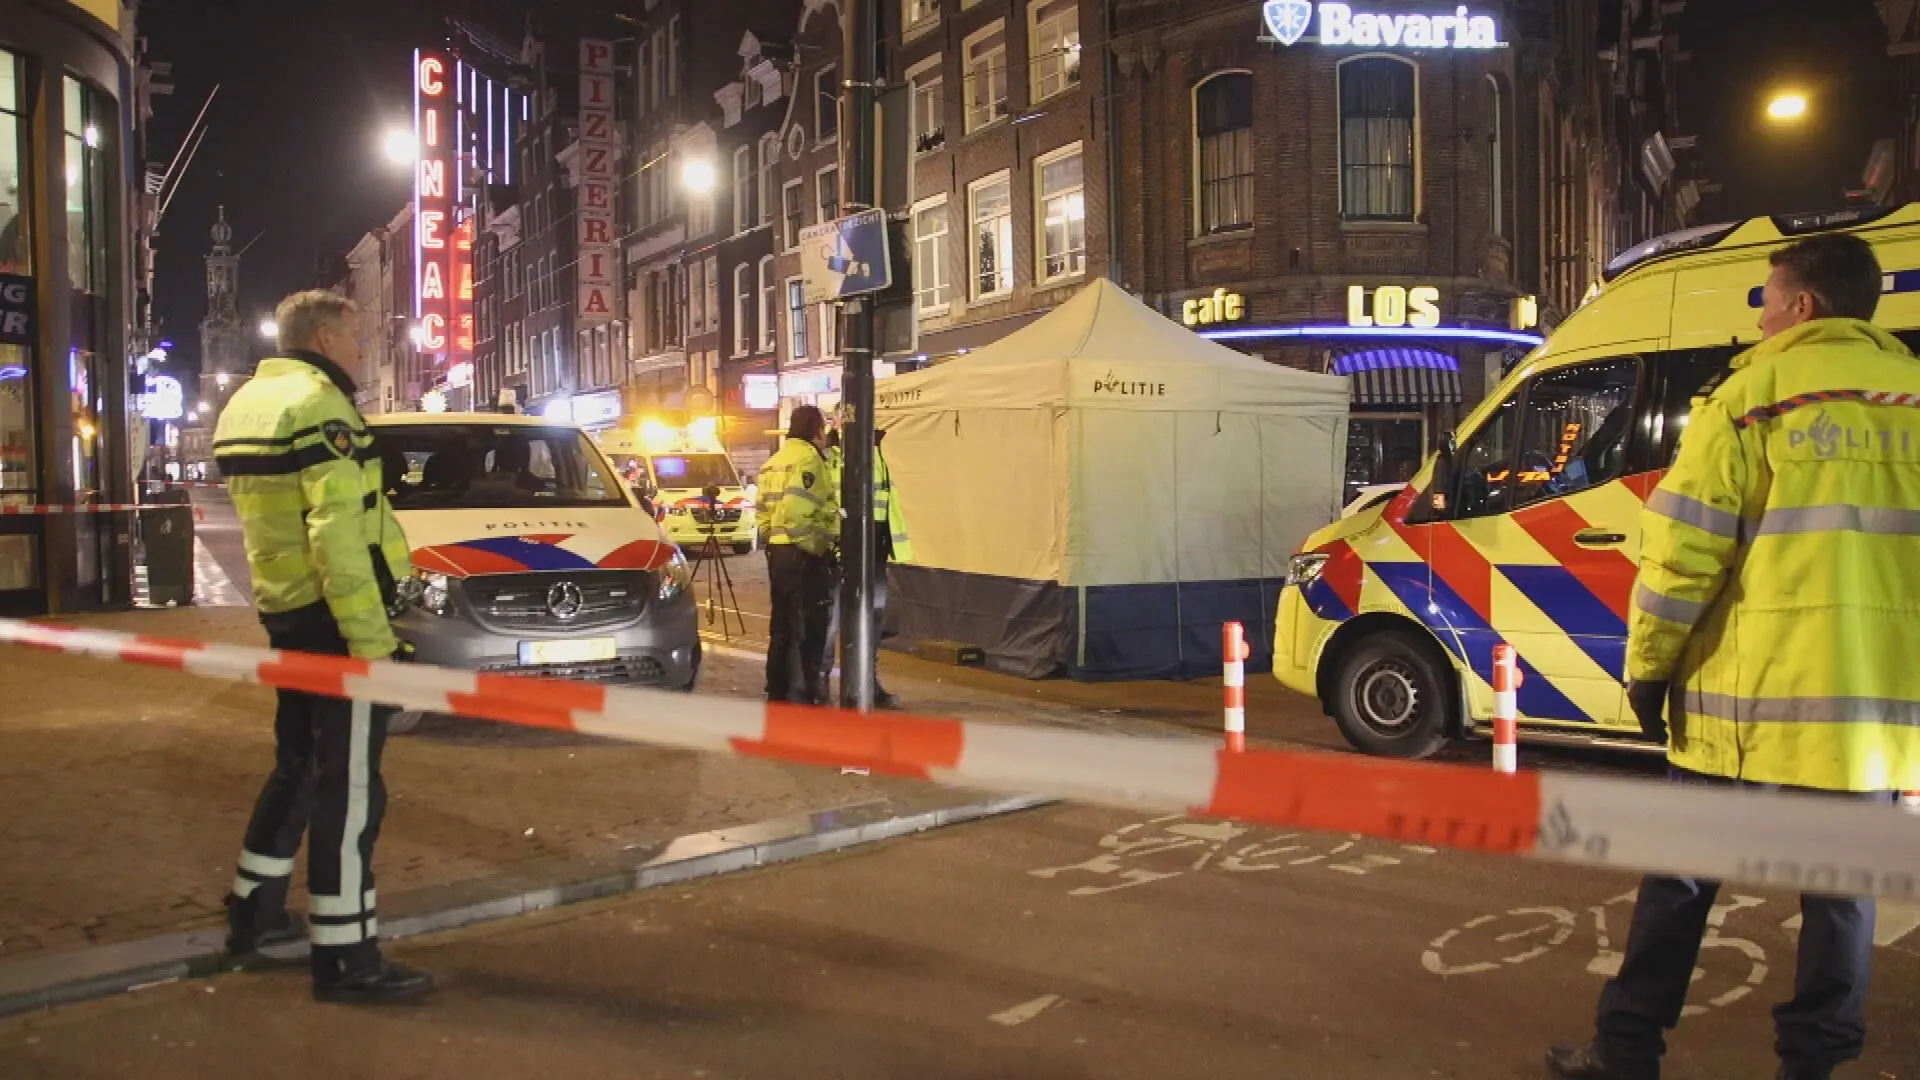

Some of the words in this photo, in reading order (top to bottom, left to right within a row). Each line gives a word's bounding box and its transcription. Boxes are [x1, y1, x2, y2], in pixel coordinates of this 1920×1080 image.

[1318, 3, 1496, 48] Bavaria
[584, 43, 610, 313] PIZZERIA
[419, 57, 446, 350] CINEAC
[0, 281, 27, 303] G
[1182, 287, 1245, 326] cafe
[1347, 285, 1441, 327] LOS
[0, 309, 28, 335] R
[1093, 371, 1166, 397] POLITIE
[485, 521, 589, 531] POLITIE
